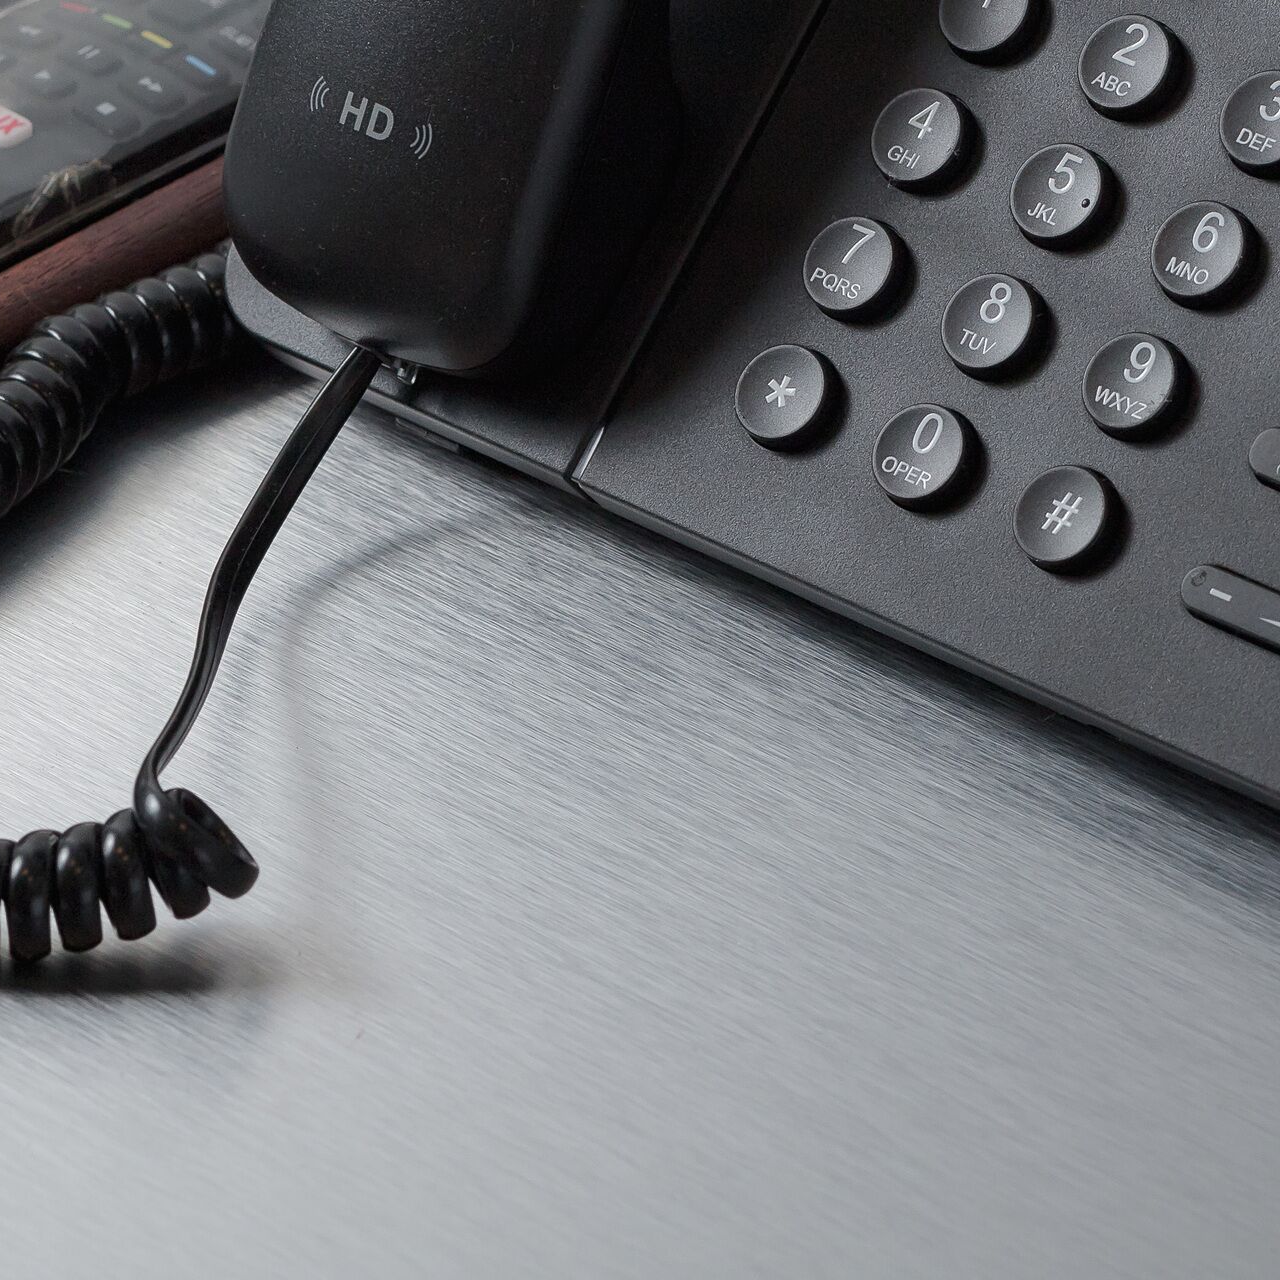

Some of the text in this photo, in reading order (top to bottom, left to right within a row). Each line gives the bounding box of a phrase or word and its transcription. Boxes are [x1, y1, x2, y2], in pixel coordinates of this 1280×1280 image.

[1111, 24, 1149, 66] 2
[1091, 70, 1131, 98] ABC
[339, 90, 395, 141] HD
[909, 101, 941, 139] 4
[887, 143, 920, 170] GHI
[1235, 127, 1277, 155] DEF
[1047, 153, 1083, 195] 5
[1027, 201, 1058, 227] JKL
[1191, 211, 1225, 254] 6
[837, 224, 876, 265] 7
[810, 266, 862, 301] PQRS
[1165, 256, 1209, 286] MNO
[979, 282, 1011, 325] 8
[959, 327, 996, 355] TUV
[1122, 342, 1156, 384] 9
[1093, 385, 1149, 420] WXYZ
[911, 410, 946, 454] 0
[881, 455, 932, 489] OPER
[1040, 490, 1085, 535] #
